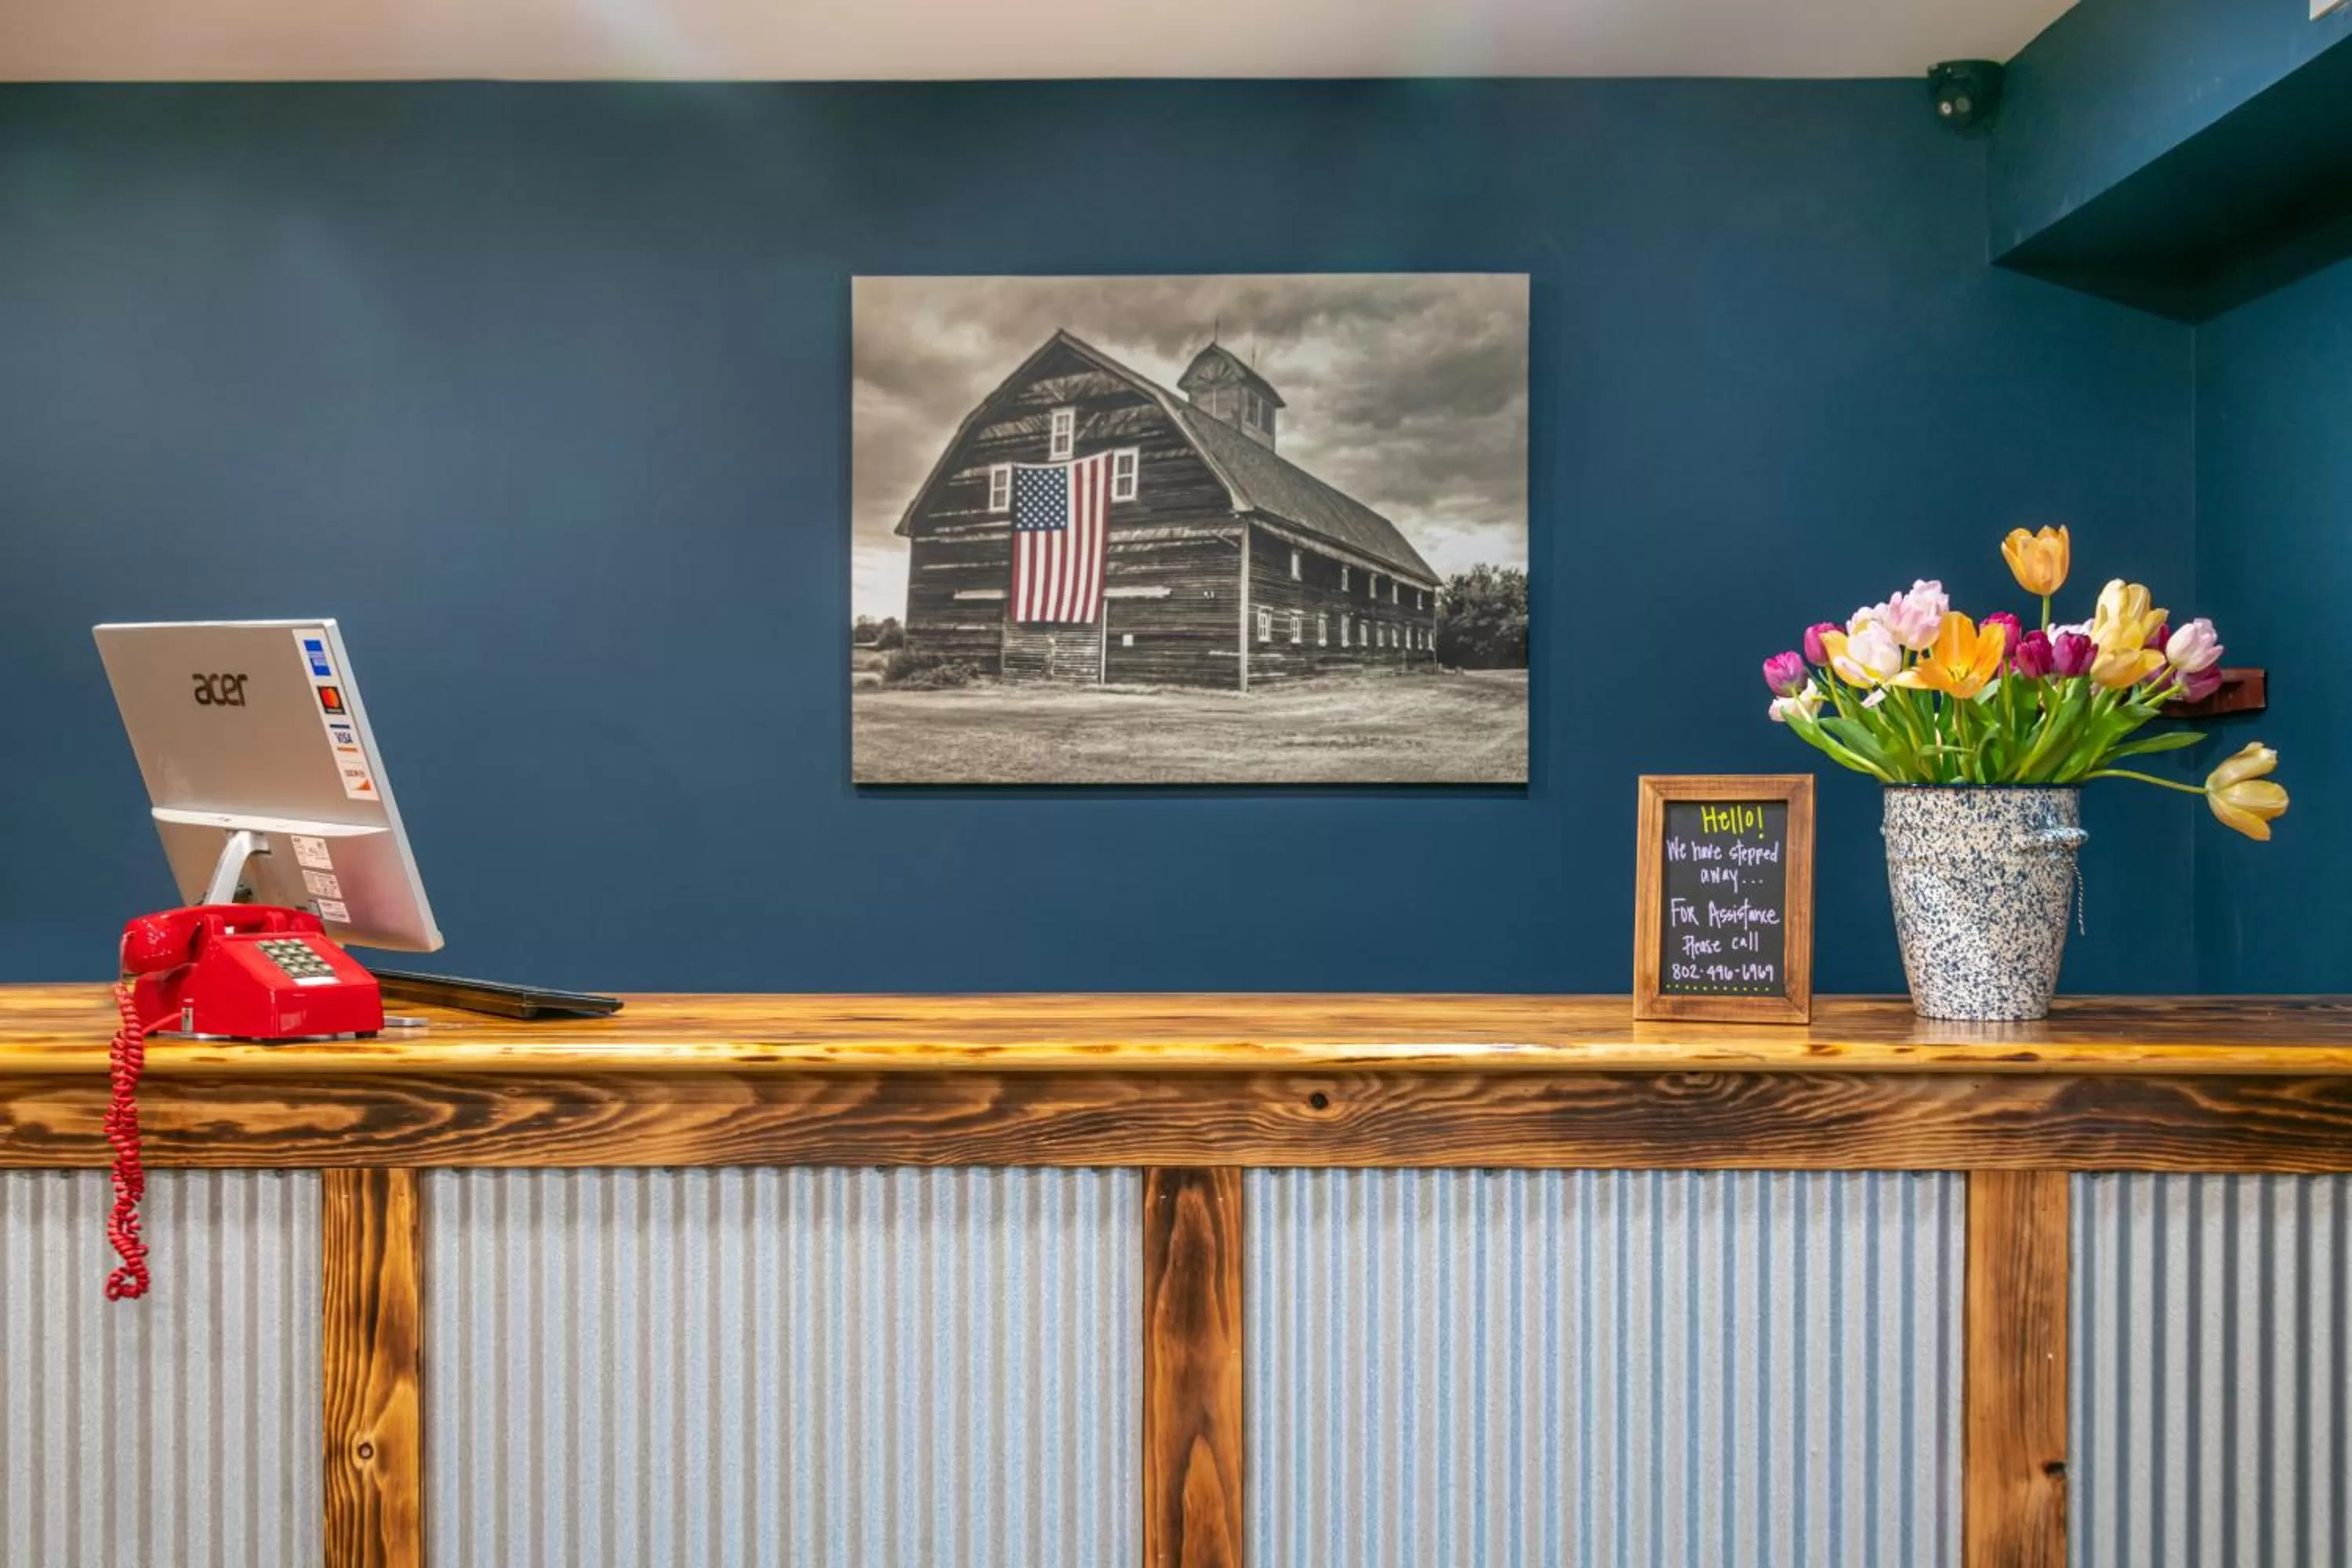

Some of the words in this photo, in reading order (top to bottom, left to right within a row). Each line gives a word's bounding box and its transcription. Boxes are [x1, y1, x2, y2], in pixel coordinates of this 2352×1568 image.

[191, 673, 248, 708] acer
[334, 731, 353, 743] VISA
[1700, 805, 1763, 839] Hello!
[1666, 836, 1686, 862] We
[1691, 840, 1722, 862] have
[1729, 839, 1779, 866] stepped
[1708, 898, 1780, 931] Assistance
[1682, 935, 1722, 959] Please
[1732, 931, 1759, 952] call
